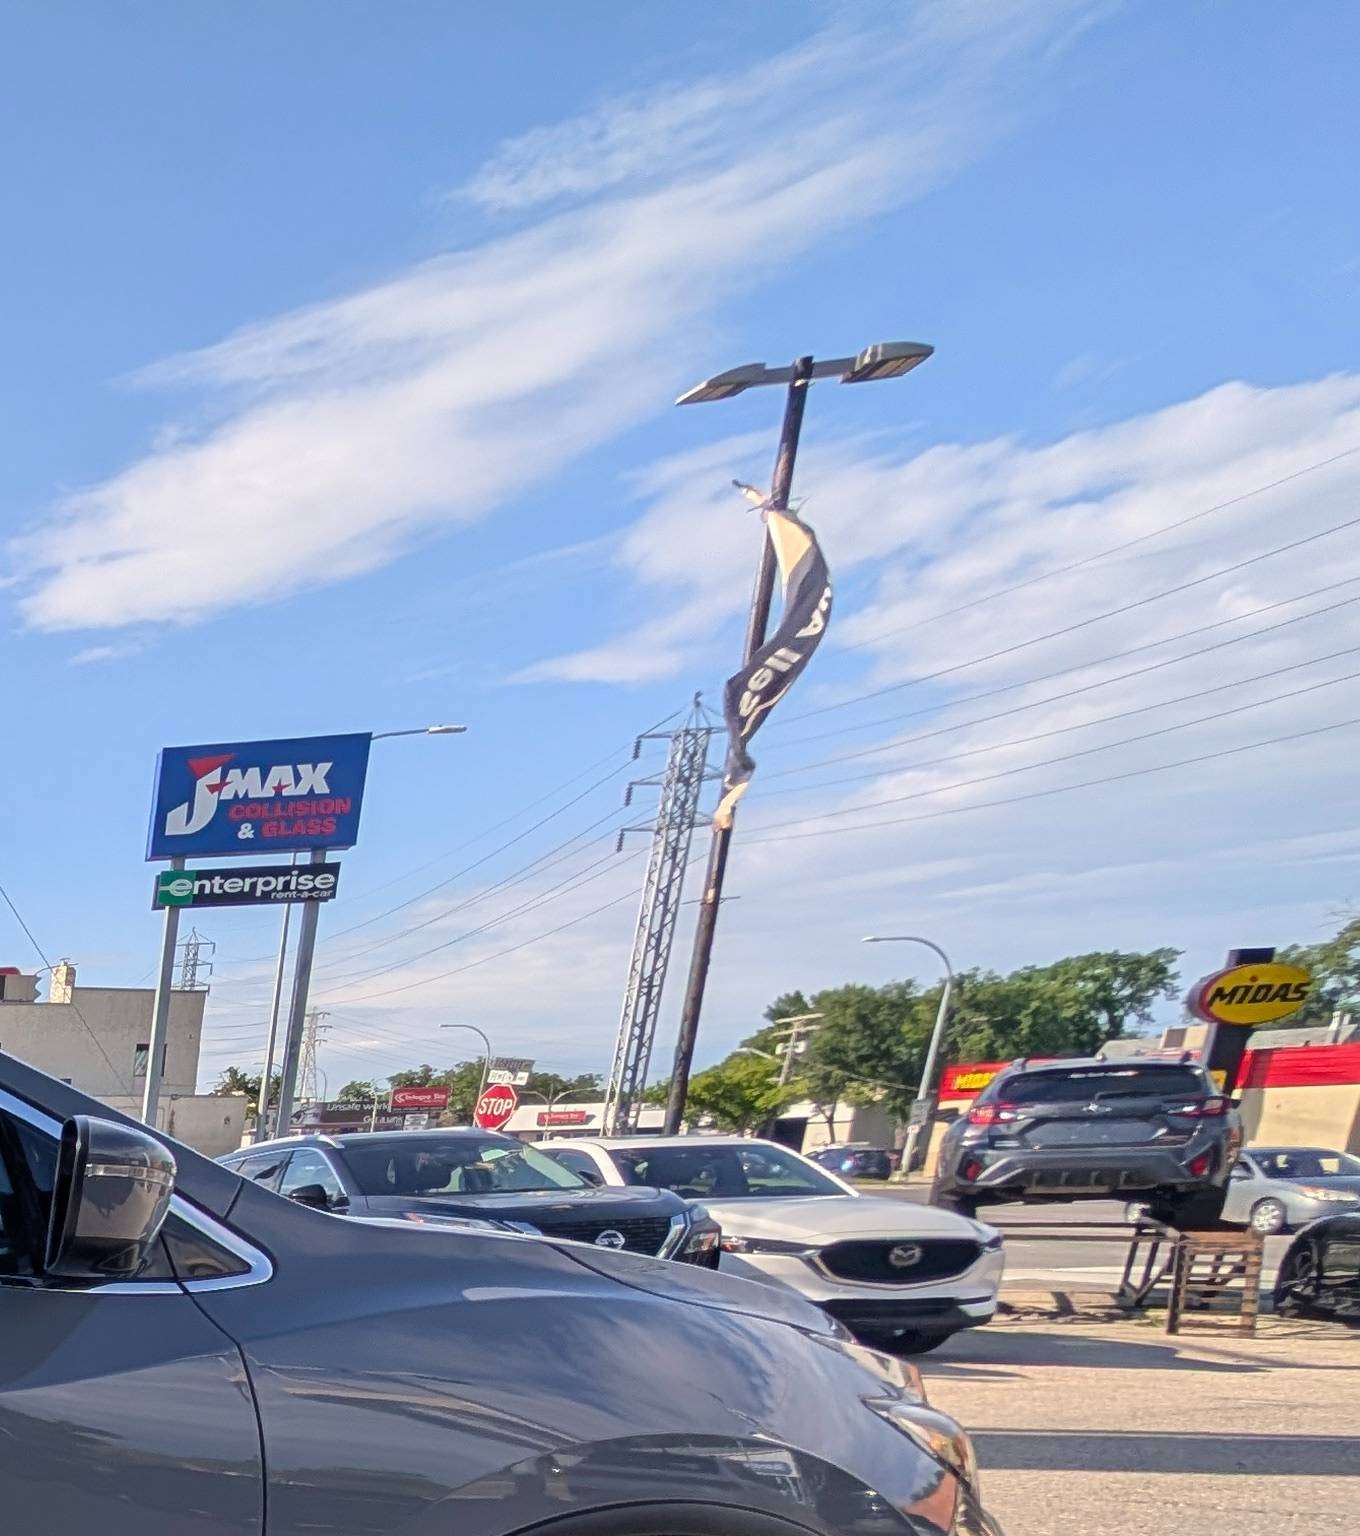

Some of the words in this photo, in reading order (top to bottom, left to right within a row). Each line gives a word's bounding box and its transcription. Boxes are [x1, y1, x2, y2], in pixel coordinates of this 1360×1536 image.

[229, 797, 351, 821] COLLISION
[237, 823, 254, 839] &
[261, 817, 336, 838] GLASS
[168, 870, 336, 897] enterprise
[1208, 977, 1312, 1008] MIDAS
[479, 1097, 513, 1116] STOP
